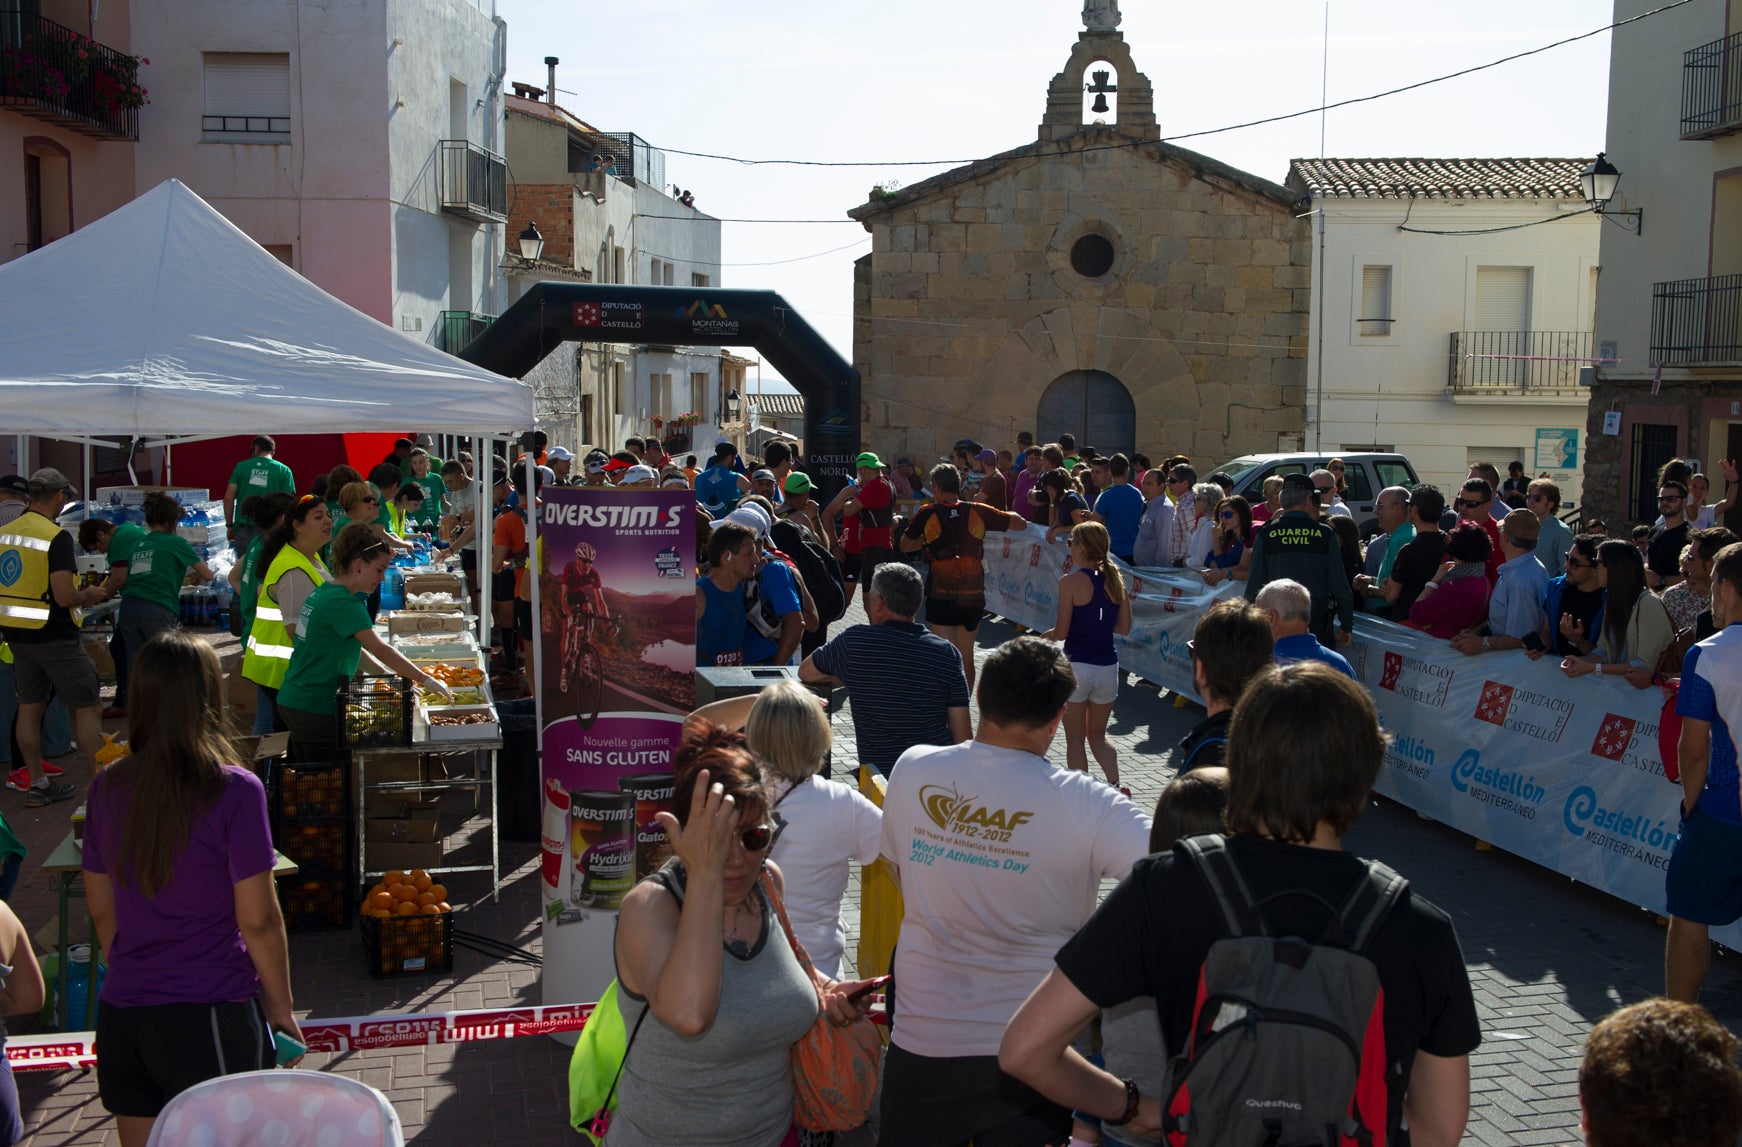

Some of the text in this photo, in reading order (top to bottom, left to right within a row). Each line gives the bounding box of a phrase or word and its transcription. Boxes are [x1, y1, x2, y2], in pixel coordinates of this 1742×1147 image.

[602, 301, 642, 310] DIPUTACIÓ
[601, 320, 642, 329] CASTELLÓ
[819, 467, 849, 476] NORD
[1269, 528, 1322, 538] GUARDIA
[1281, 536, 1310, 545] CIVIL
[132, 551, 154, 560] STAFF
[716, 652, 737, 664] 0120
[1402, 655, 1450, 679] DIPUTACIÓ
[1394, 683, 1442, 708] CASTELLÓ
[1437, 682, 1444, 693] E
[1513, 688, 1571, 713] DIPUTACIÓ
[1508, 703, 1565, 728] D E
[1503, 718, 1557, 743] CASTELLÓ
[583, 735, 670, 749] Nouvelle gamme
[1629, 737, 1639, 750] D
[566, 748, 671, 766] SANS GLUTEN
[1450, 748, 1546, 804] Castellón
[1470, 786, 1537, 820] MEDITERRÁNEO
[957, 804, 1035, 831] IAAF
[952, 822, 1012, 842] 1912-2012
[914, 827, 926, 836] 100
[926, 831, 945, 842] Years
[953, 838, 987, 852] Athletics
[988, 844, 1030, 858] Excellence
[910, 850, 936, 866] 2012
[912, 838, 1030, 874] World Athletics Day
[1246, 1098, 1302, 1110] Quechua
